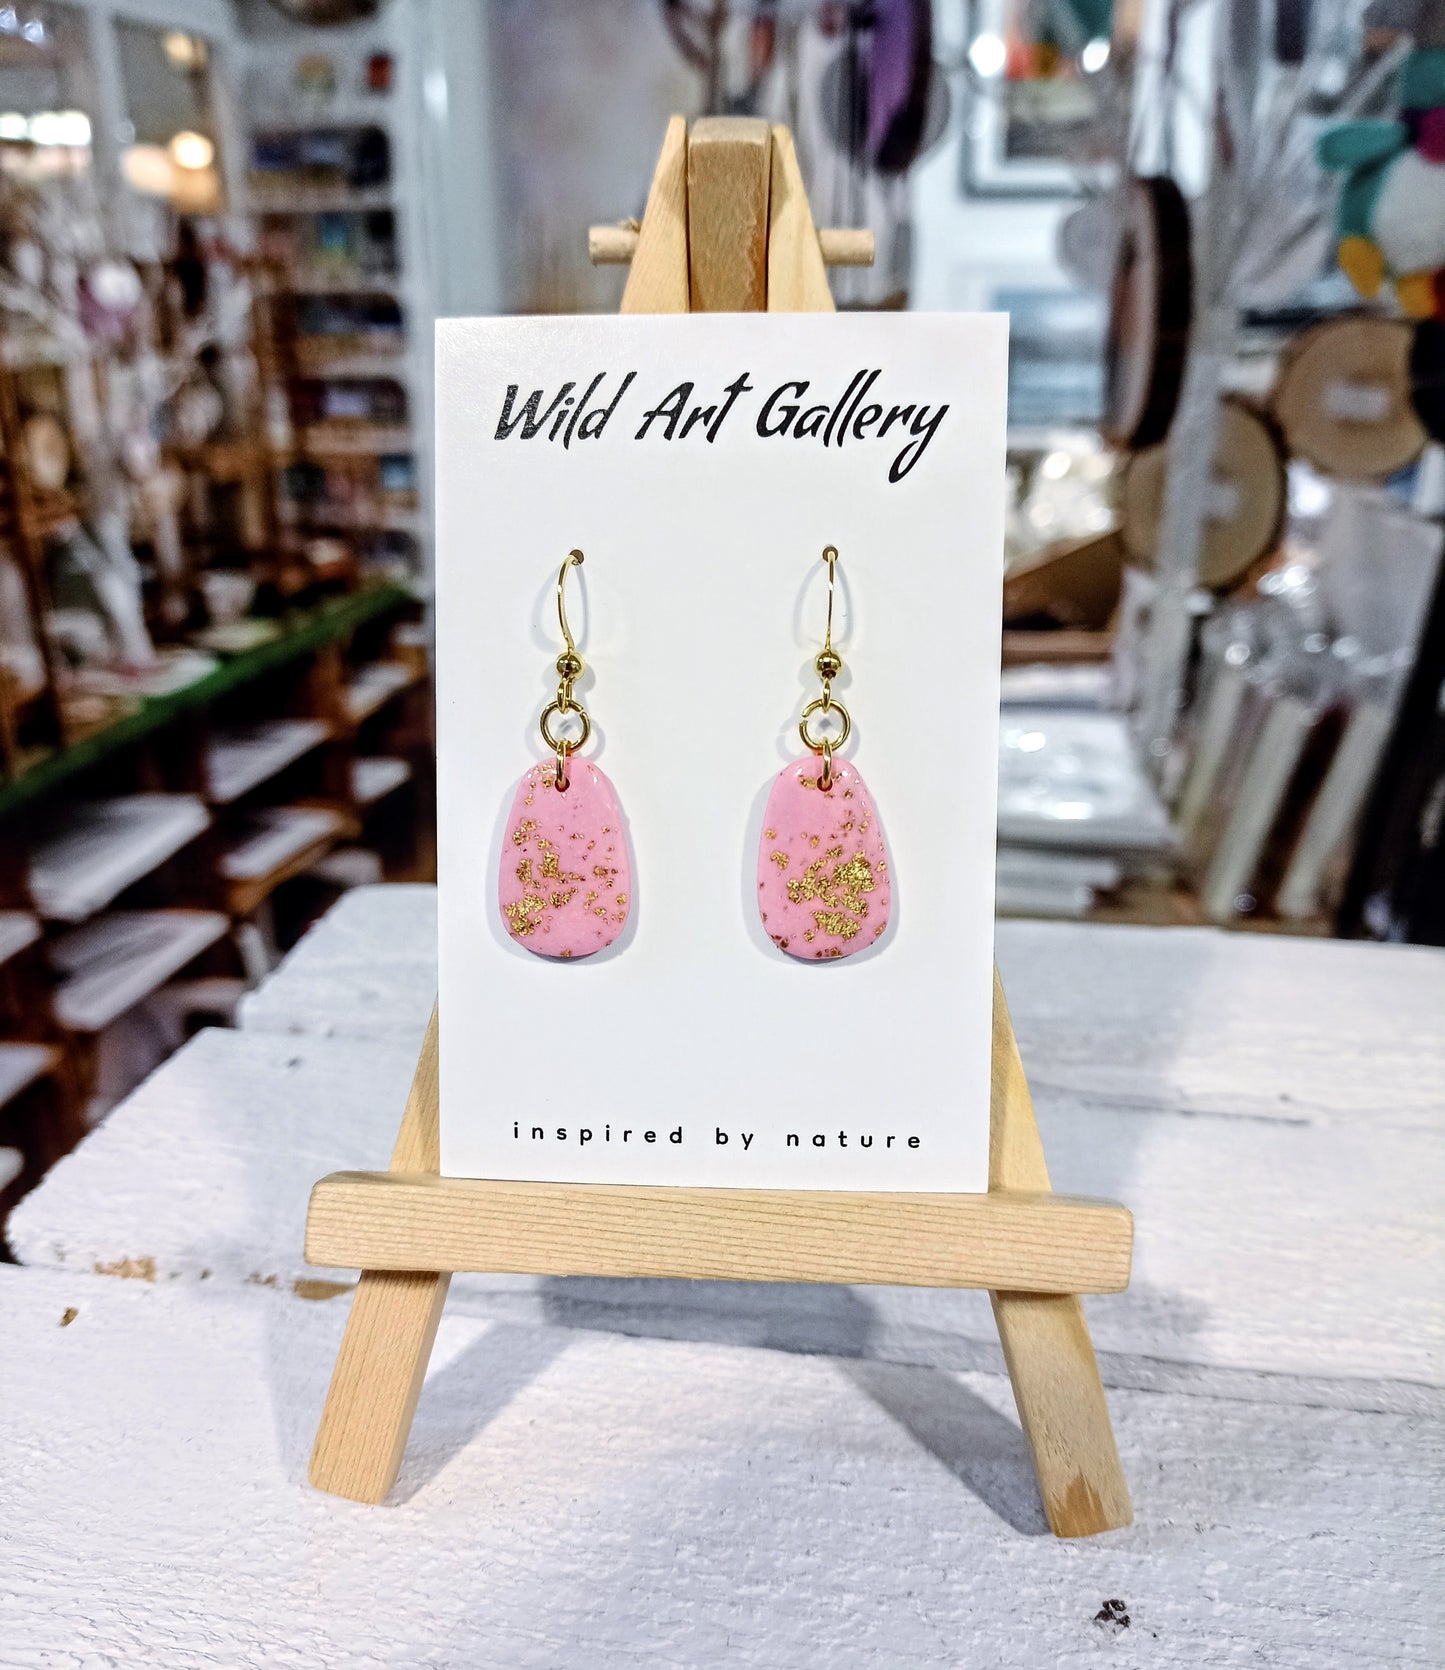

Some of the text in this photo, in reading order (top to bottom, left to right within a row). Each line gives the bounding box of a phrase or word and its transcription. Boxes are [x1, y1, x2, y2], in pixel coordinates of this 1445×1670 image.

[493, 368, 950, 484] Wild Art Gallery
[513, 1121, 922, 1151] inspired by nature
